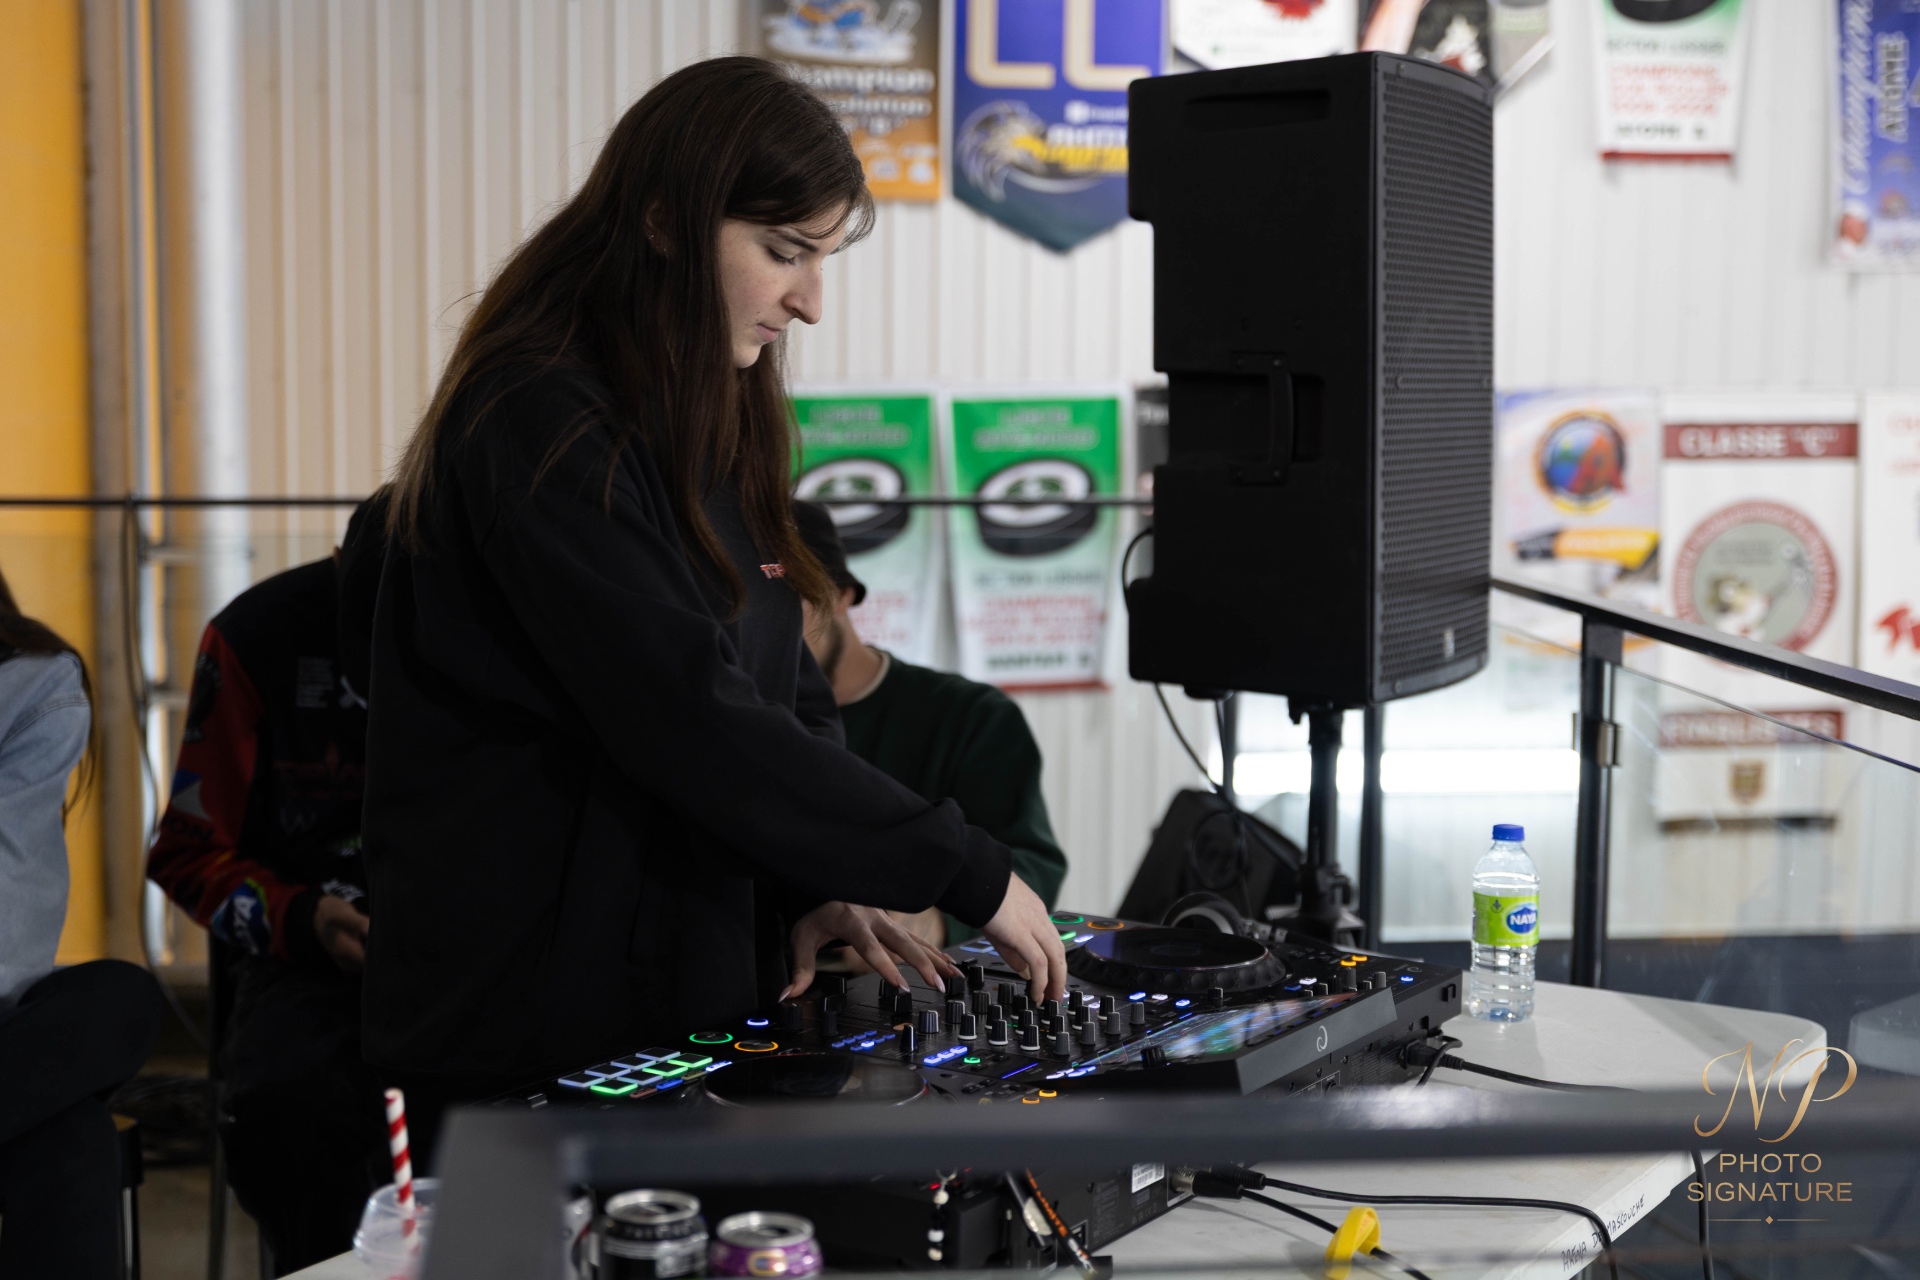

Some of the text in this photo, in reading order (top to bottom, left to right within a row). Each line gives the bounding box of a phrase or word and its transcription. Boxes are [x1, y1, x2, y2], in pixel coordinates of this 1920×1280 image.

[1680, 427, 1788, 455] CLASSE
[1509, 912, 1537, 926] NAYA
[1606, 1193, 1645, 1237] MASCOUCHE
